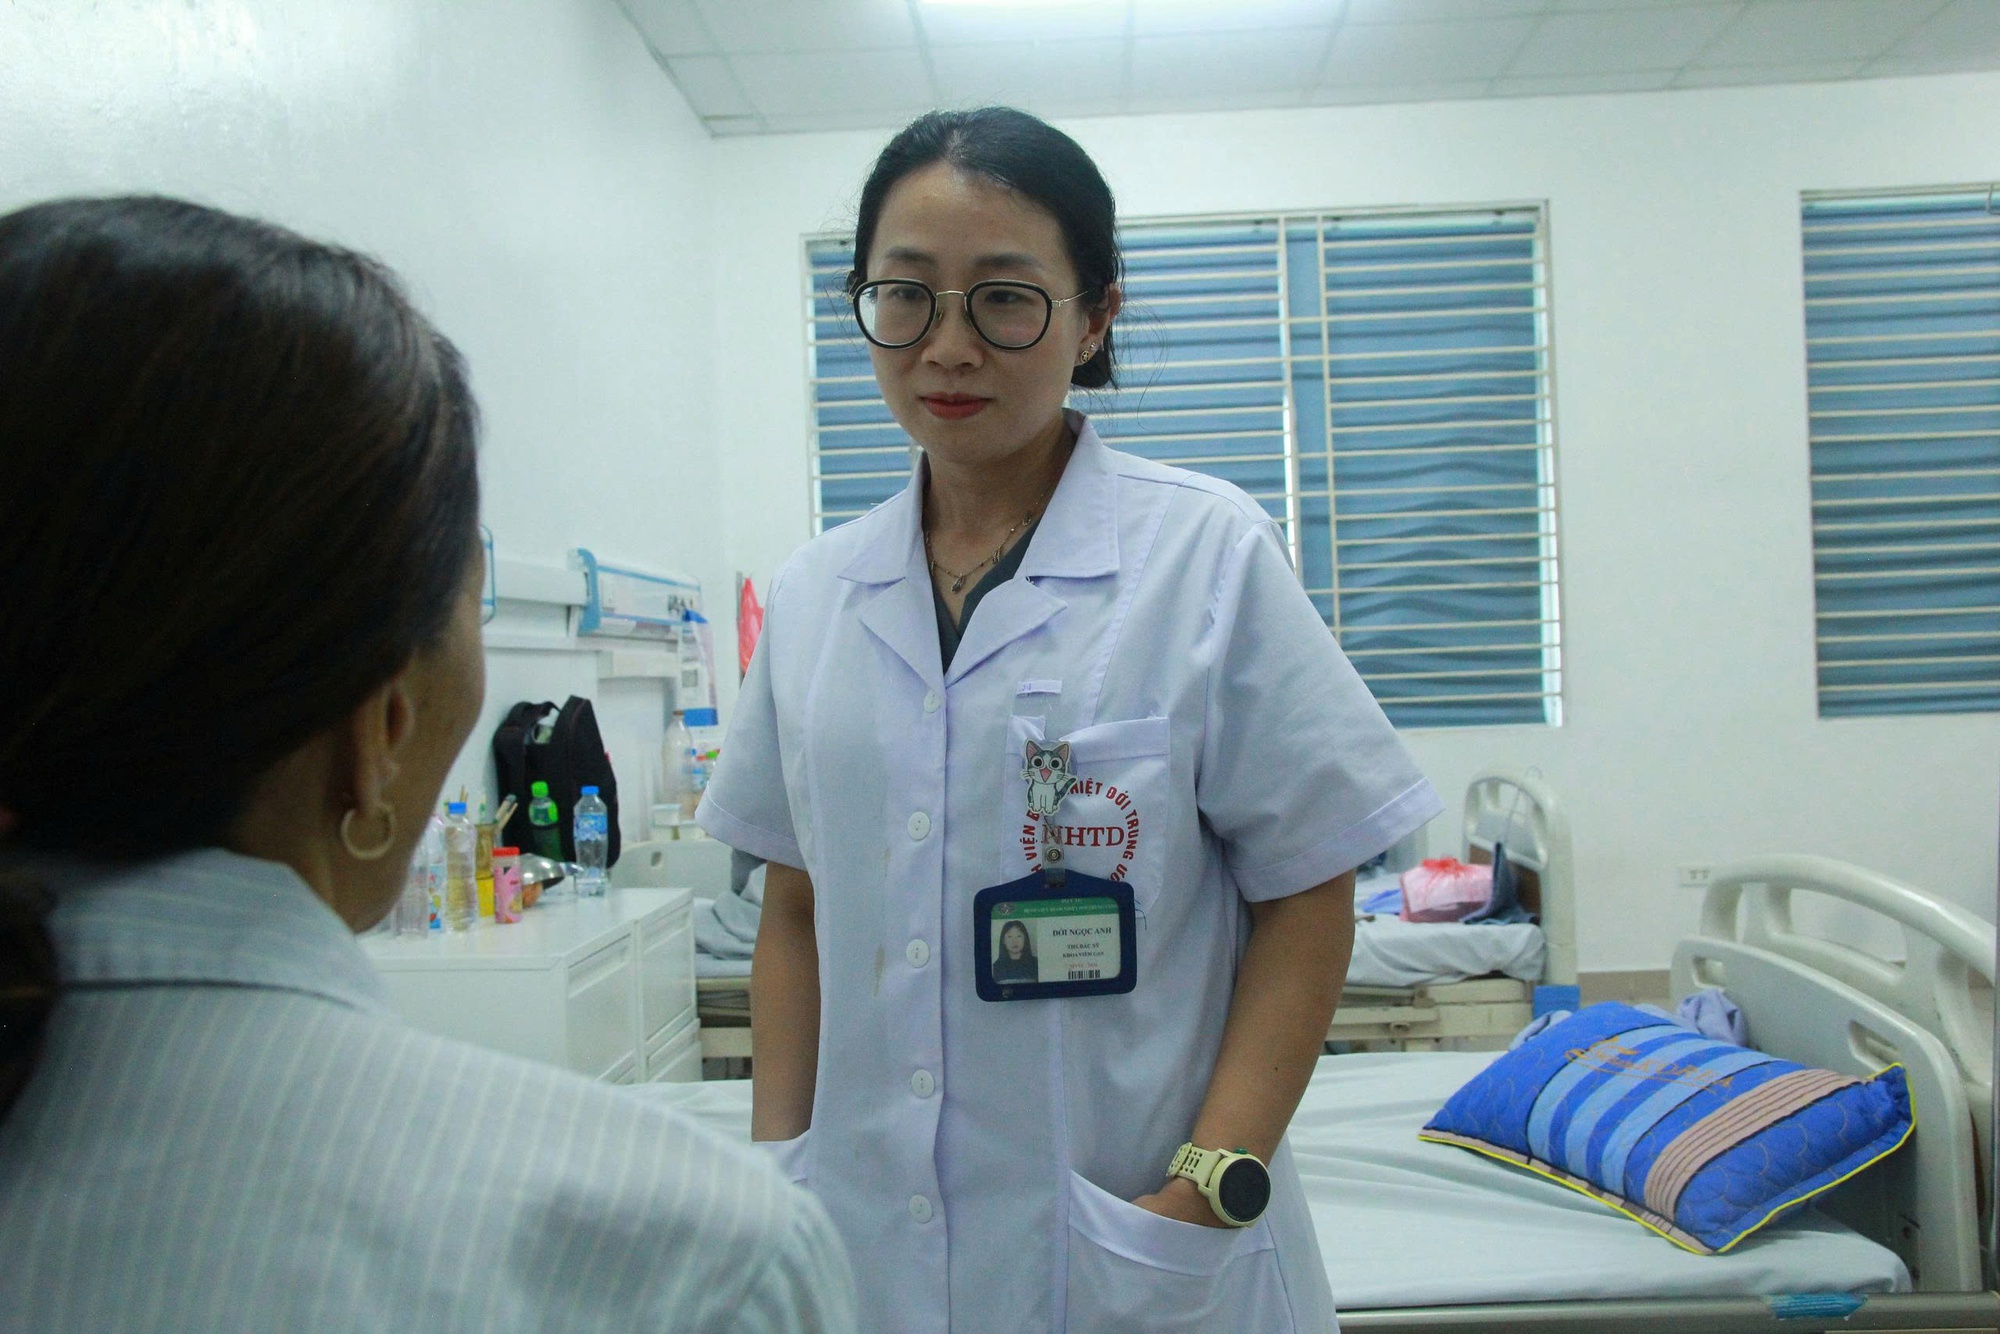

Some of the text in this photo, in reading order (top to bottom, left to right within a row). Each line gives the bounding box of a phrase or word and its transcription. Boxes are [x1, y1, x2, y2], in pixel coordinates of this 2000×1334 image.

[1041, 824, 1125, 847] NHTD
[1067, 777, 1103, 797] HIỆT
[1106, 786, 1131, 811] ĐỚI
[1123, 809, 1139, 860] TRUNG
